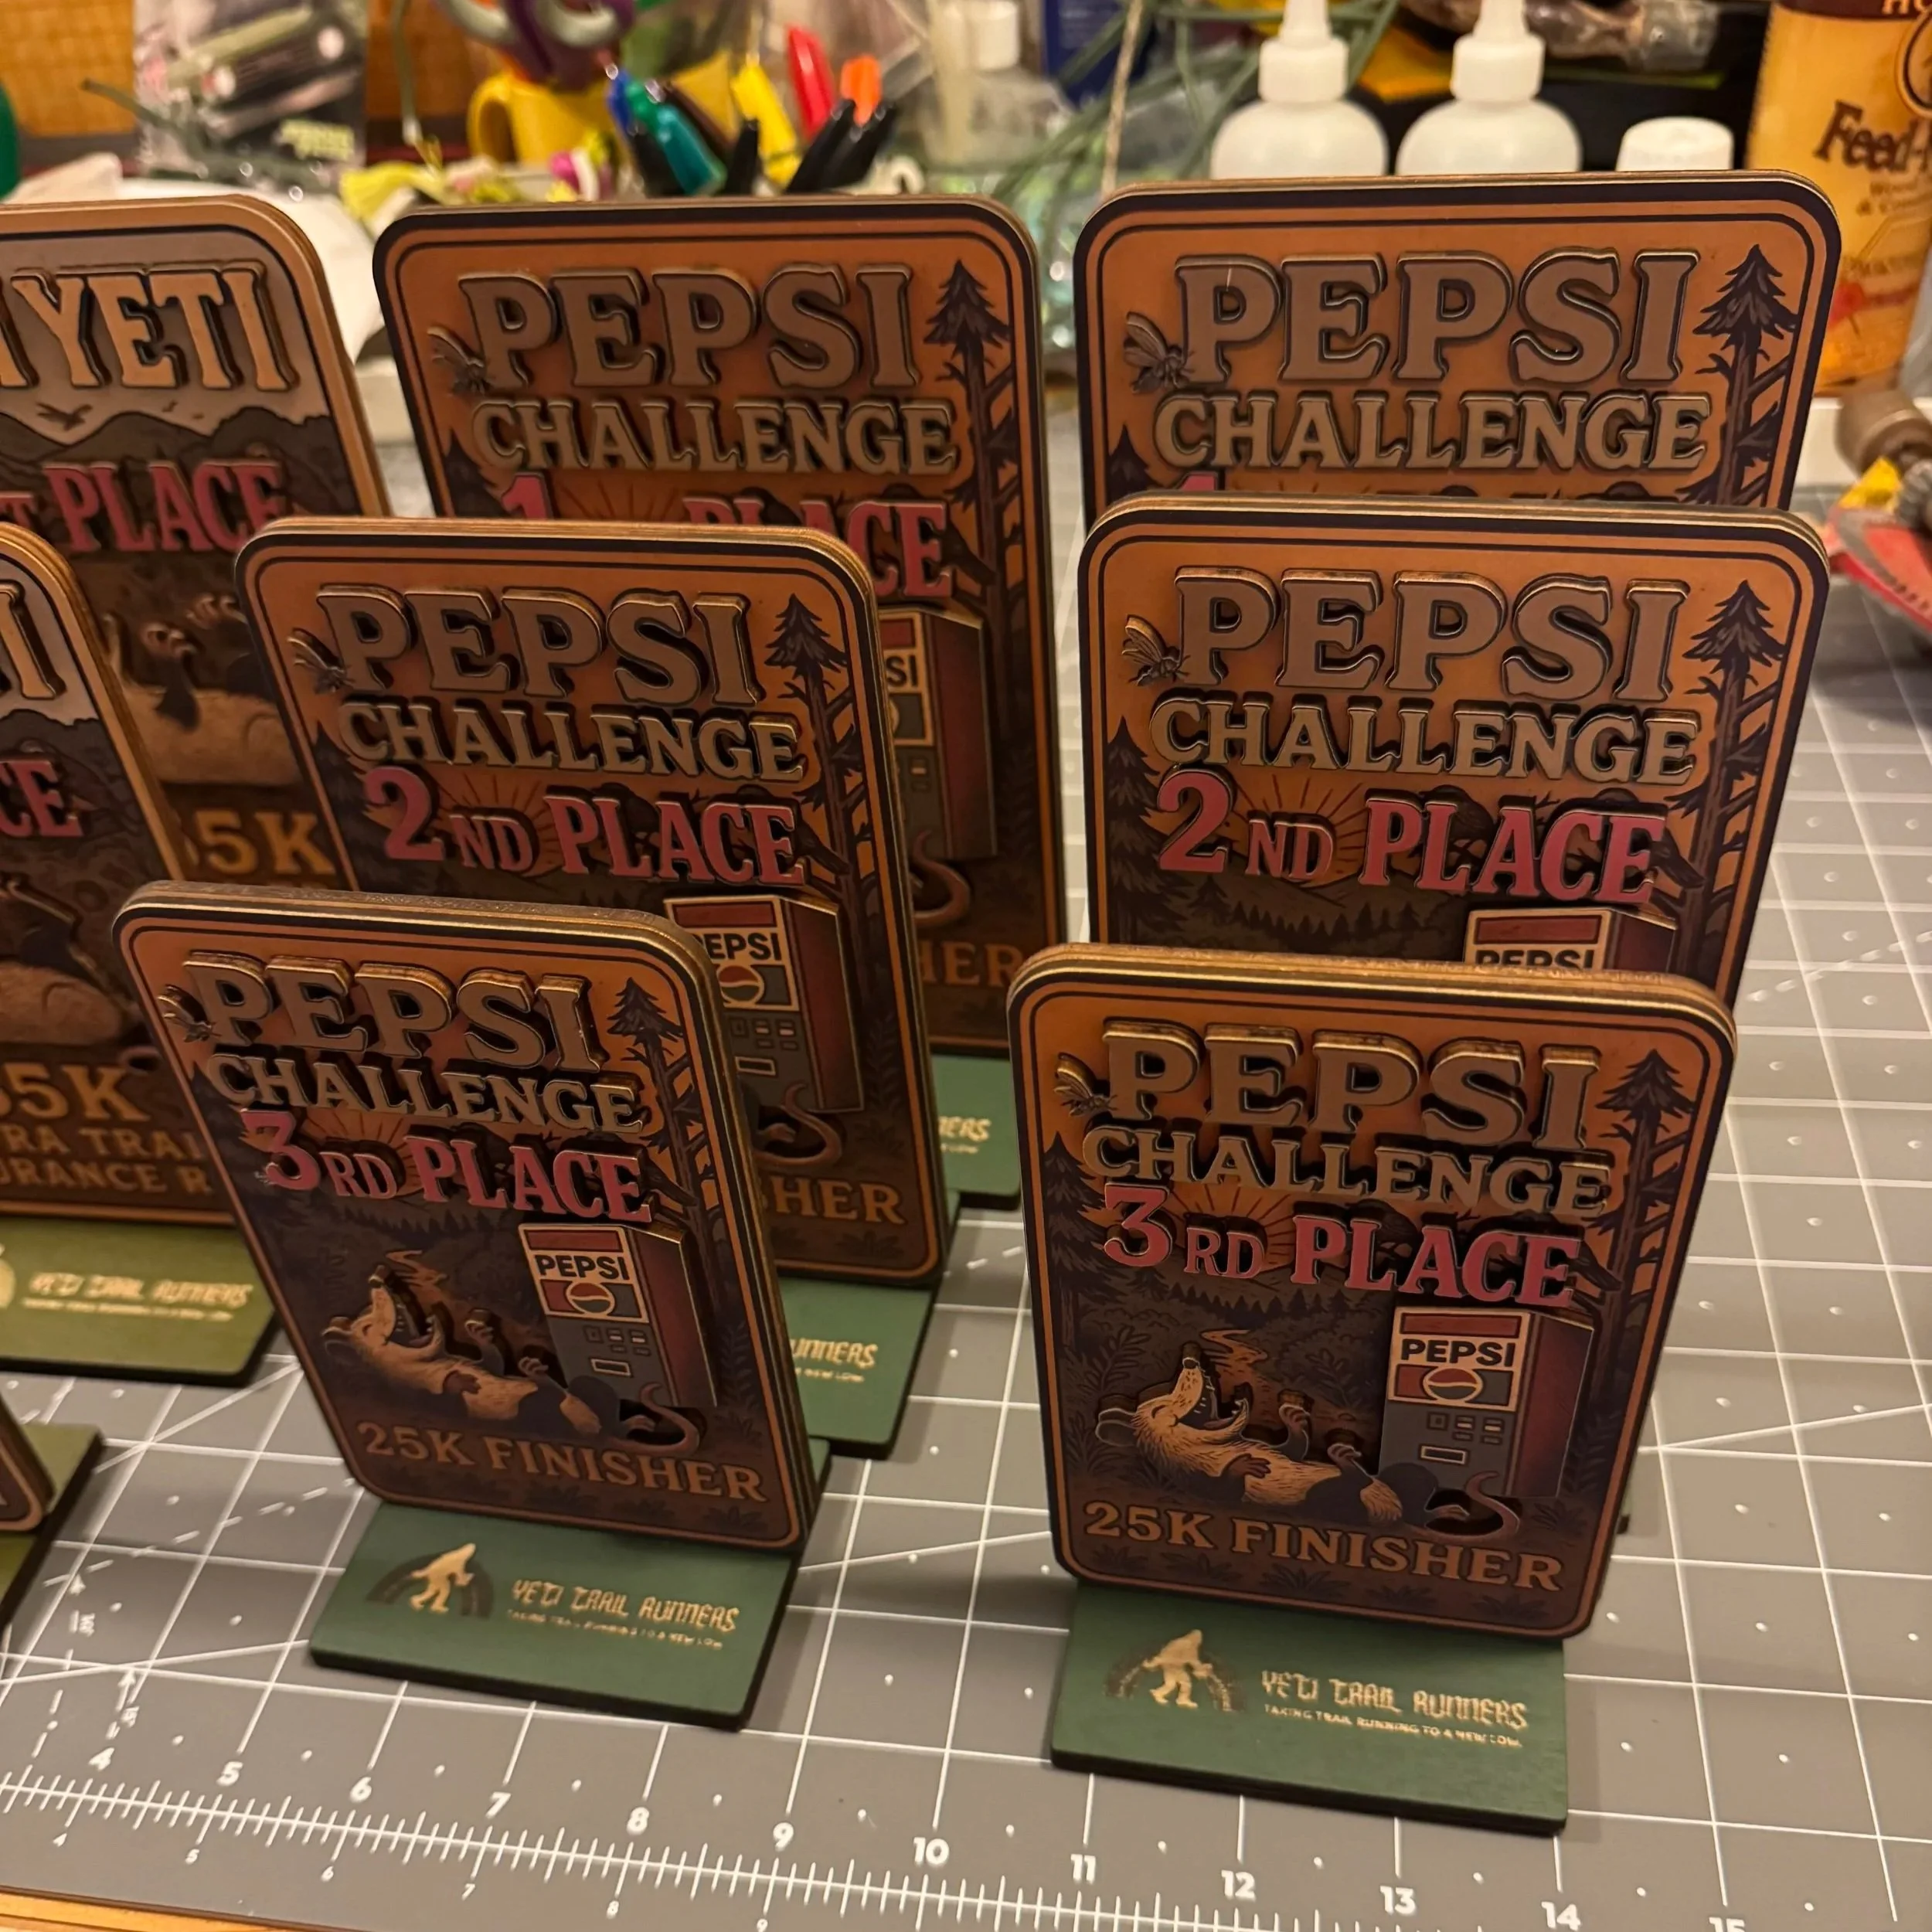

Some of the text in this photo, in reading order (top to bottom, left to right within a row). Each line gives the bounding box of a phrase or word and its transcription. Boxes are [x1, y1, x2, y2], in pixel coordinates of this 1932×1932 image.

[457, 264, 921, 389] PEPSI
[1173, 247, 1700, 384] PEPSI
[471, 397, 958, 474] CHALLENGE
[1154, 391, 1711, 471] CHALLENGE
[43, 457, 287, 552] PLACE
[317, 585, 761, 706] PEPSI
[1173, 566, 1691, 702] PEPSI
[338, 698, 808, 782] CHALLENGE
[1148, 690, 1700, 785] CHALLENGE
[193, 808, 338, 876] 5K
[545, 787, 806, 886] PLACE
[1359, 794, 1666, 904] PLACE
[700, 932, 782, 962] EPSI
[183, 951, 609, 1074] PEPSI
[0, 1062, 151, 1121] 5K
[207, 1053, 648, 1133] CHALLENGE
[1101, 1019, 1602, 1151] PEPSI
[404, 1134, 653, 1223] PLACE
[1082, 1121, 1614, 1217] CHALLENGE
[770, 1176, 905, 1226] HER
[539, 1253, 629, 1281] PEPSI
[1291, 1204, 1582, 1308] PLACE
[1400, 1338, 1516, 1368] PEPSI
[355, 1420, 768, 1503] 25K FINISHER
[1083, 1501, 1563, 1592] 25K FINISHER
[638, 1597, 740, 1633] RUNNERS
[1262, 1670, 1529, 1731] YETI TRAIL RUNNERS
[217, 1761, 243, 1786] 5
[350, 1777, 372, 1802] 6
[485, 1792, 512, 1818] 7
[627, 1806, 650, 1835] 8
[773, 1821, 794, 1851] 9
[913, 1836, 951, 1866] 10
[321, 1866, 335, 1882] 6
[461, 1883, 475, 1900] 7
[1070, 1853, 1097, 1885] 11
[1221, 1869, 1256, 1901] 12
[607, 1900, 620, 1920] 8
[756, 1918, 768, 1932] 9
[1379, 1885, 1417, 1917] 13
[1541, 1902, 1581, 1931] 14
